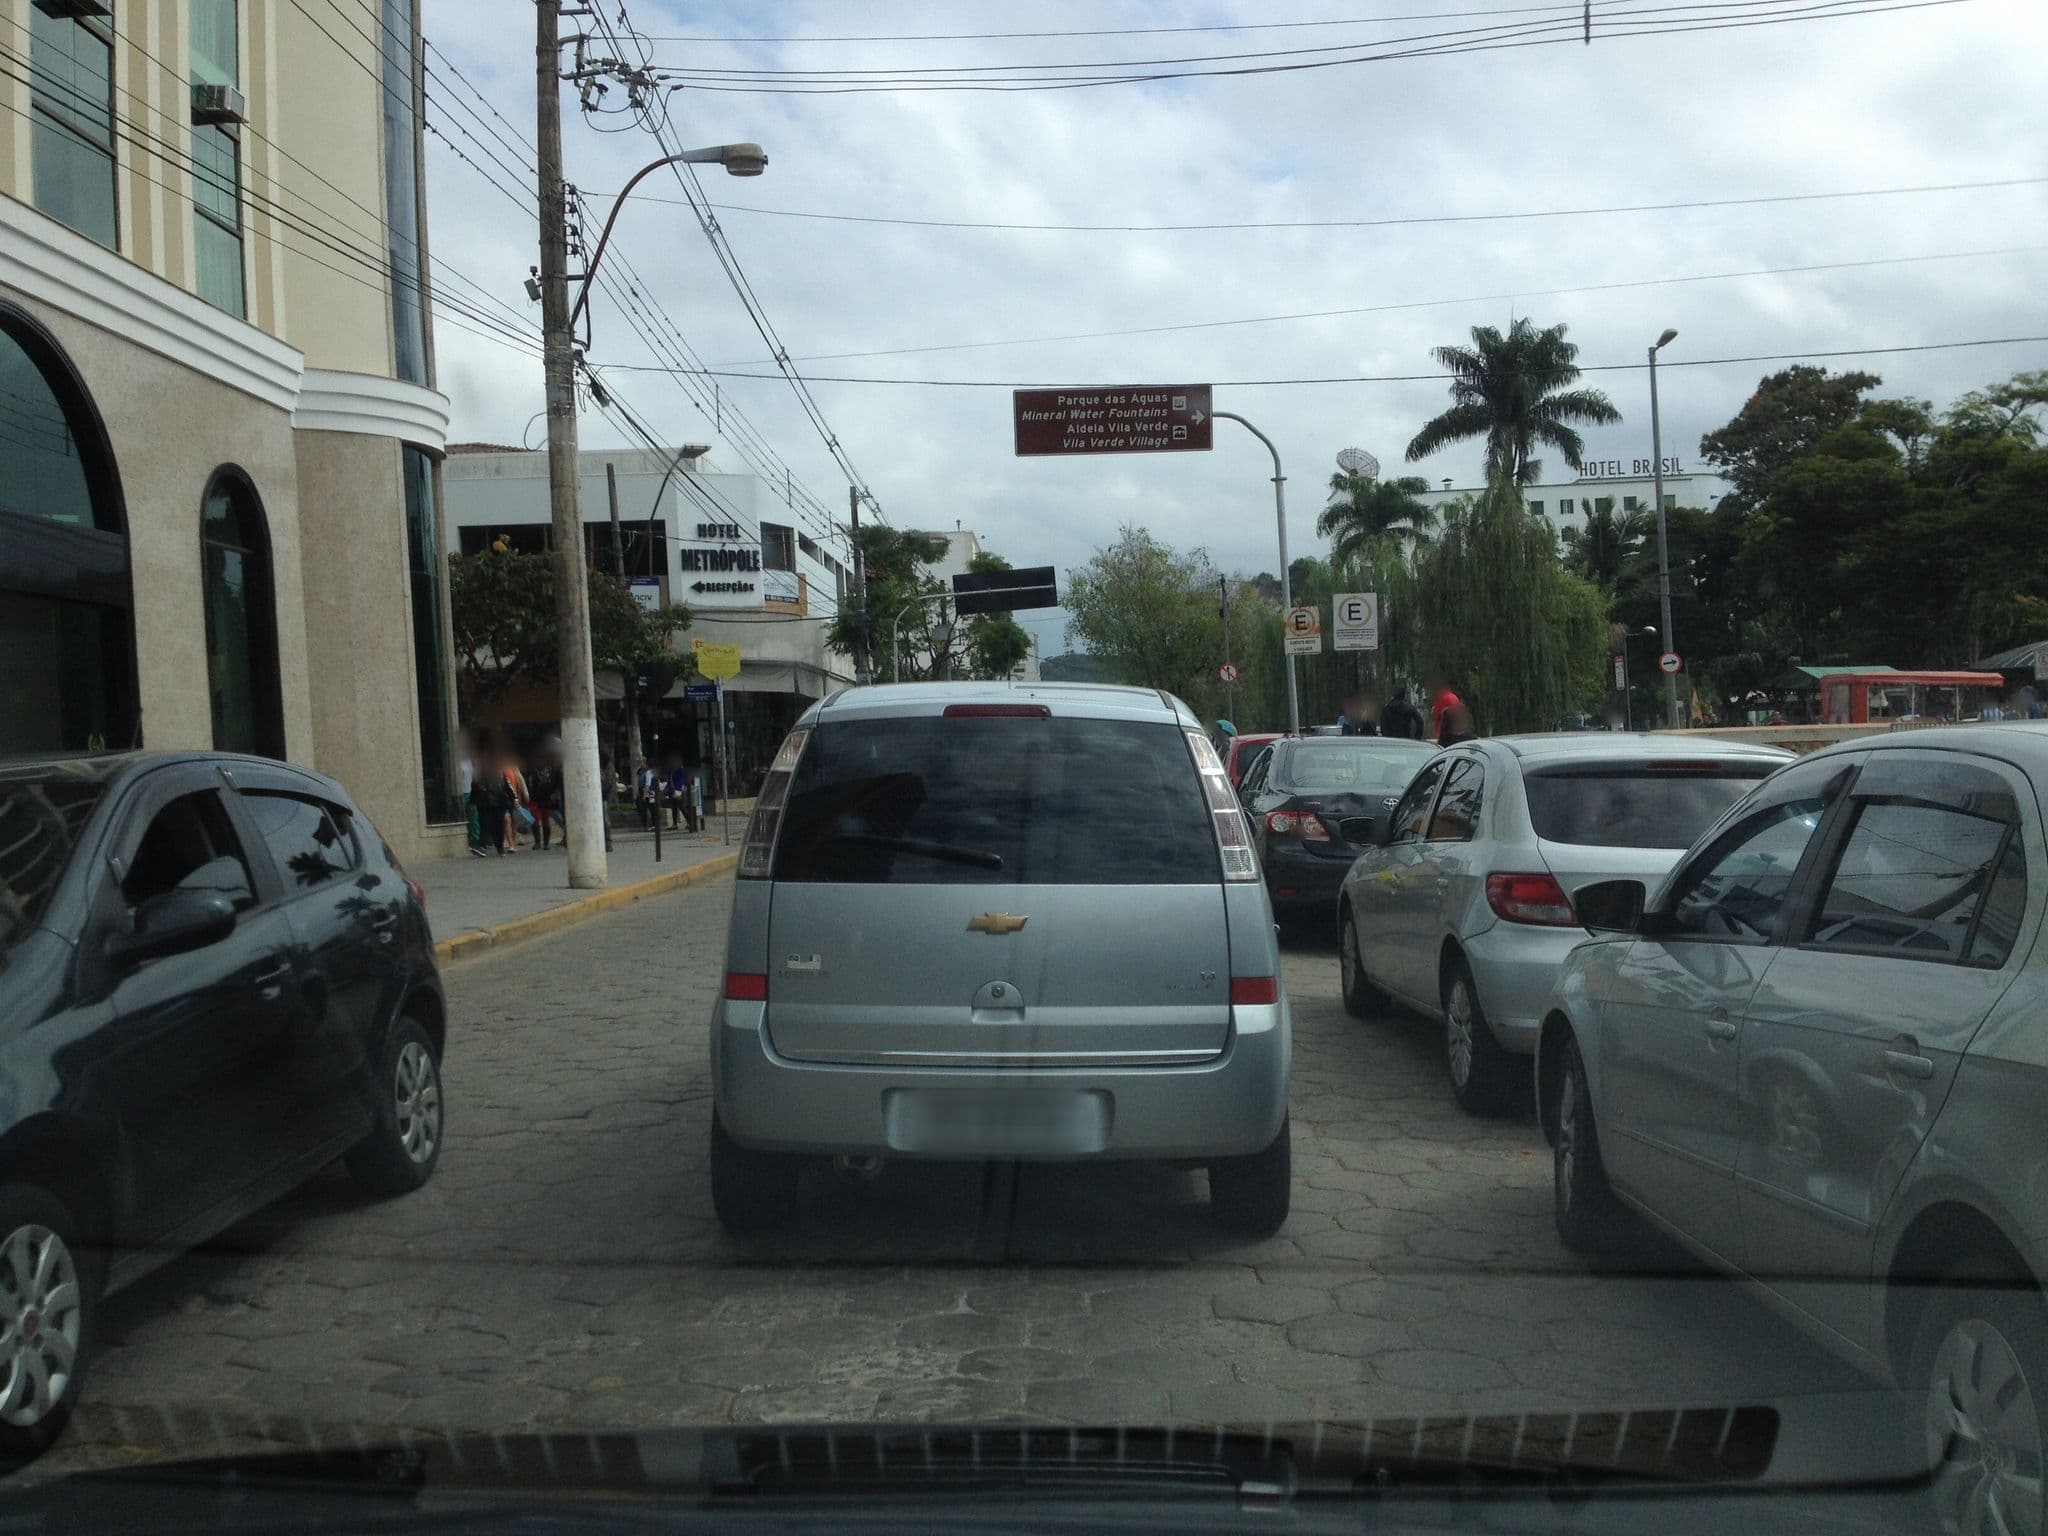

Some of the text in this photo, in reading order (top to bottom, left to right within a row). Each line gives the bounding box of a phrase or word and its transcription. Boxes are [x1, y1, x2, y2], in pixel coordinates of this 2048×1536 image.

[1057, 395, 1100, 407] Parque
[1105, 394, 1126, 404] das
[1022, 407, 1168, 421] Mineral Water Fountains
[1067, 420, 1168, 433] Aldeia Vila Verde
[1063, 435, 1169, 449] Vila Verde Village
[1580, 460, 1625, 477] HOTEL
[697, 523, 741, 539] HOTEL
[681, 542, 761, 572] METRÓPOLE
[1348, 603, 1361, 621] E
[1295, 614, 1307, 631] E
